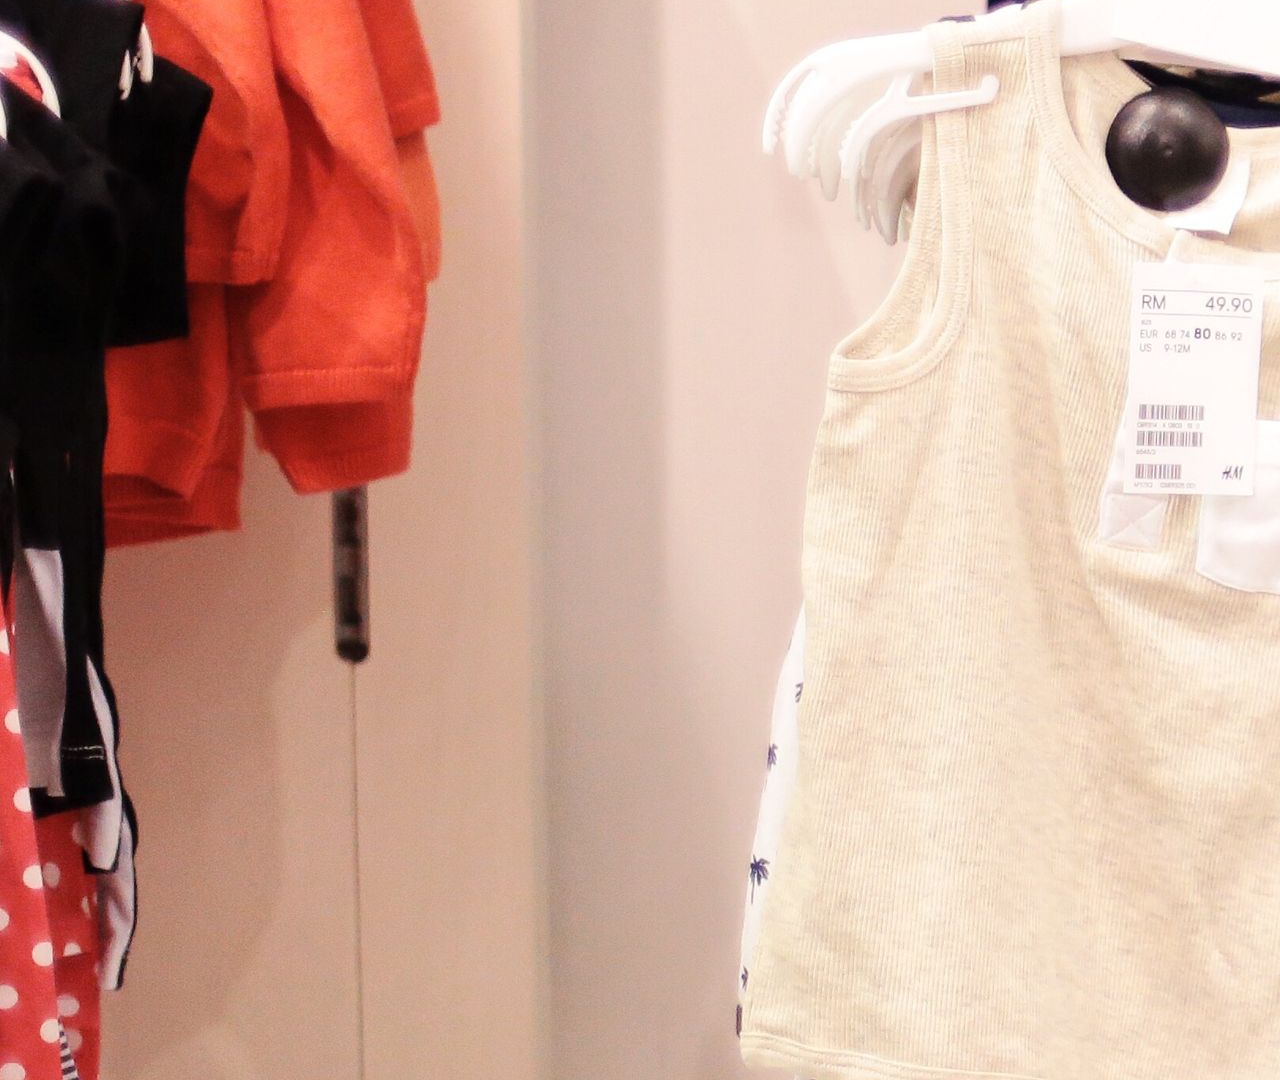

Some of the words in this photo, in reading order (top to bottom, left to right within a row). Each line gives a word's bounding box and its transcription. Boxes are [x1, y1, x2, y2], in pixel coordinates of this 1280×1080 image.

[1141, 294, 1166, 310] RM
[1205, 296, 1253, 313] 49.90
[1140, 329, 1158, 339] EUR
[1165, 329, 1177, 339] 68
[1180, 330, 1190, 339] 74
[1194, 327, 1211, 340] 80
[1215, 331, 1227, 341] 86
[1230, 332, 1243, 341] 92
[1139, 343, 1152, 353] US
[1164, 344, 1191, 353] 9-12M
